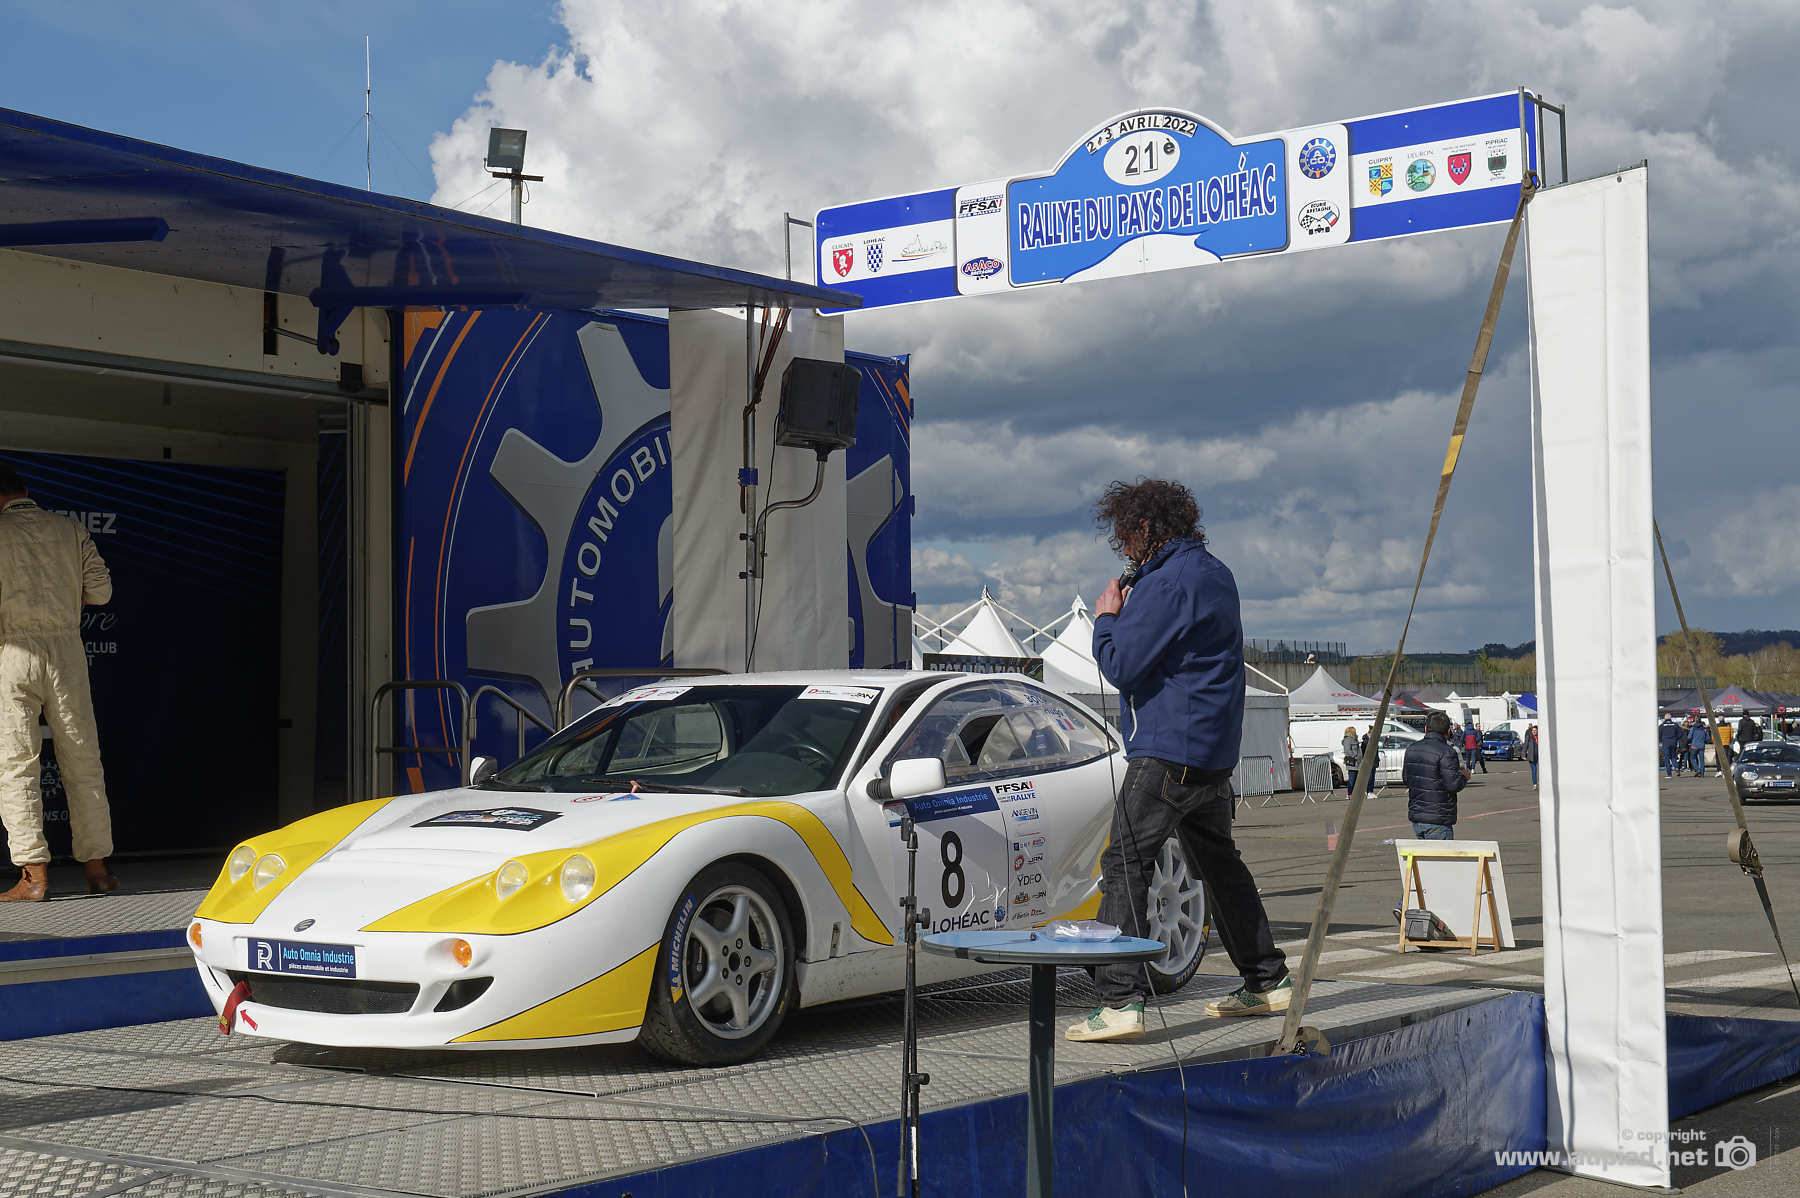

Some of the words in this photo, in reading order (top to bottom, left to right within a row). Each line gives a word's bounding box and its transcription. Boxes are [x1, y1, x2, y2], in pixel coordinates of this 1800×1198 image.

[1120, 116, 1160, 133] AVRIL
[1163, 116, 1196, 135] 2022
[1019, 200, 1081, 251] RALLYE
[1085, 196, 1113, 243] DU
[1117, 187, 1164, 237] PAYS
[1167, 182, 1193, 230] DE
[1197, 152, 1277, 226] LOHÉAC
[569, 430, 672, 688] AUTOMOBI
[85, 642, 117, 655] CLUB
[914, 801, 931, 810] Auto
[932, 798, 956, 808] Omnia
[956, 791, 989, 804] Industrie
[1010, 793, 1036, 802] RALLYE
[940, 830, 965, 908] 8
[932, 910, 990, 934] LOHÉAC
[671, 899, 694, 971] MICHELIN
[283, 947, 299, 960] Auto
[300, 948, 322, 962] Omnia
[323, 949, 354, 964] Industrie
